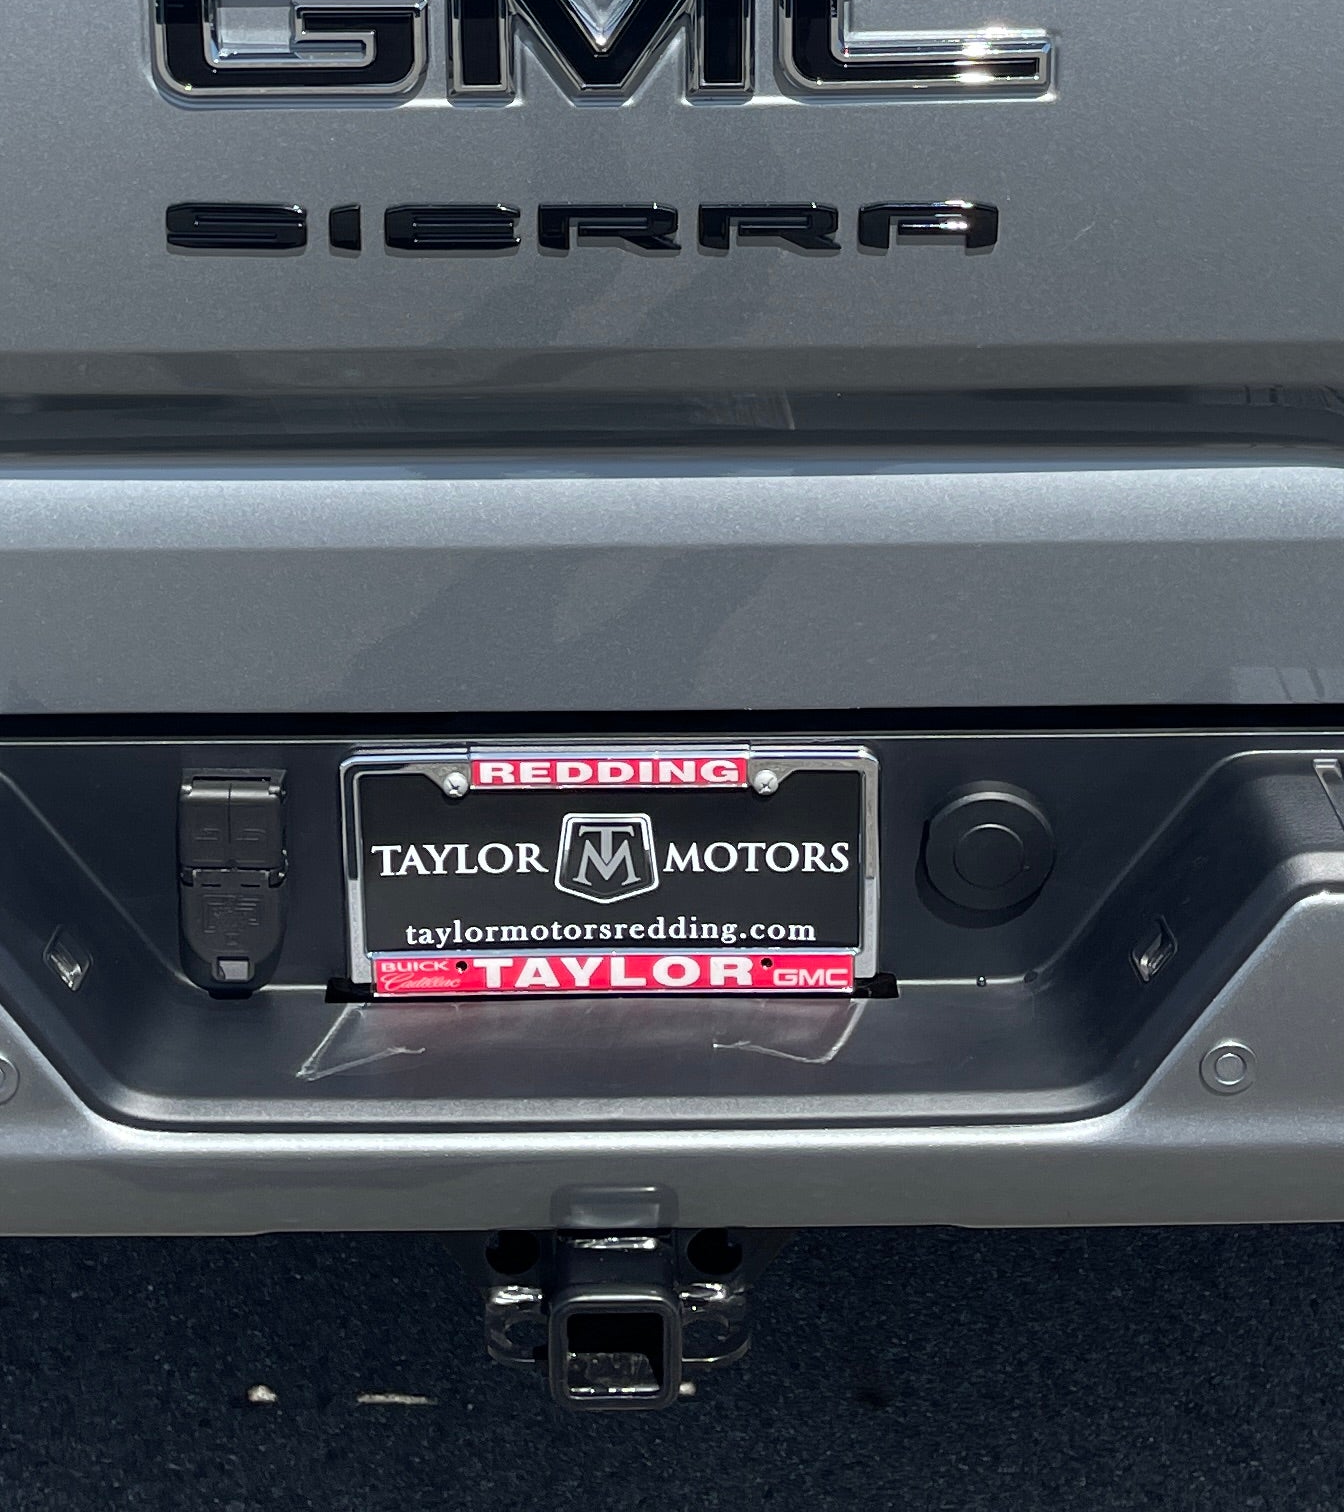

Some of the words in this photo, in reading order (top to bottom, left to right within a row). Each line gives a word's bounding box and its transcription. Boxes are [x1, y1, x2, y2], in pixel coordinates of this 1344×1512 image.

[165, 201, 999, 254] SIERRA
[478, 760, 740, 785] REDDING
[371, 842, 549, 877] TAYLOR
[662, 841, 849, 875] MOTORS
[405, 916, 817, 948] taylormotorsredding.com
[380, 960, 450, 973] BUICK
[472, 956, 755, 989] TAYLOR
[772, 968, 849, 986] GMC
